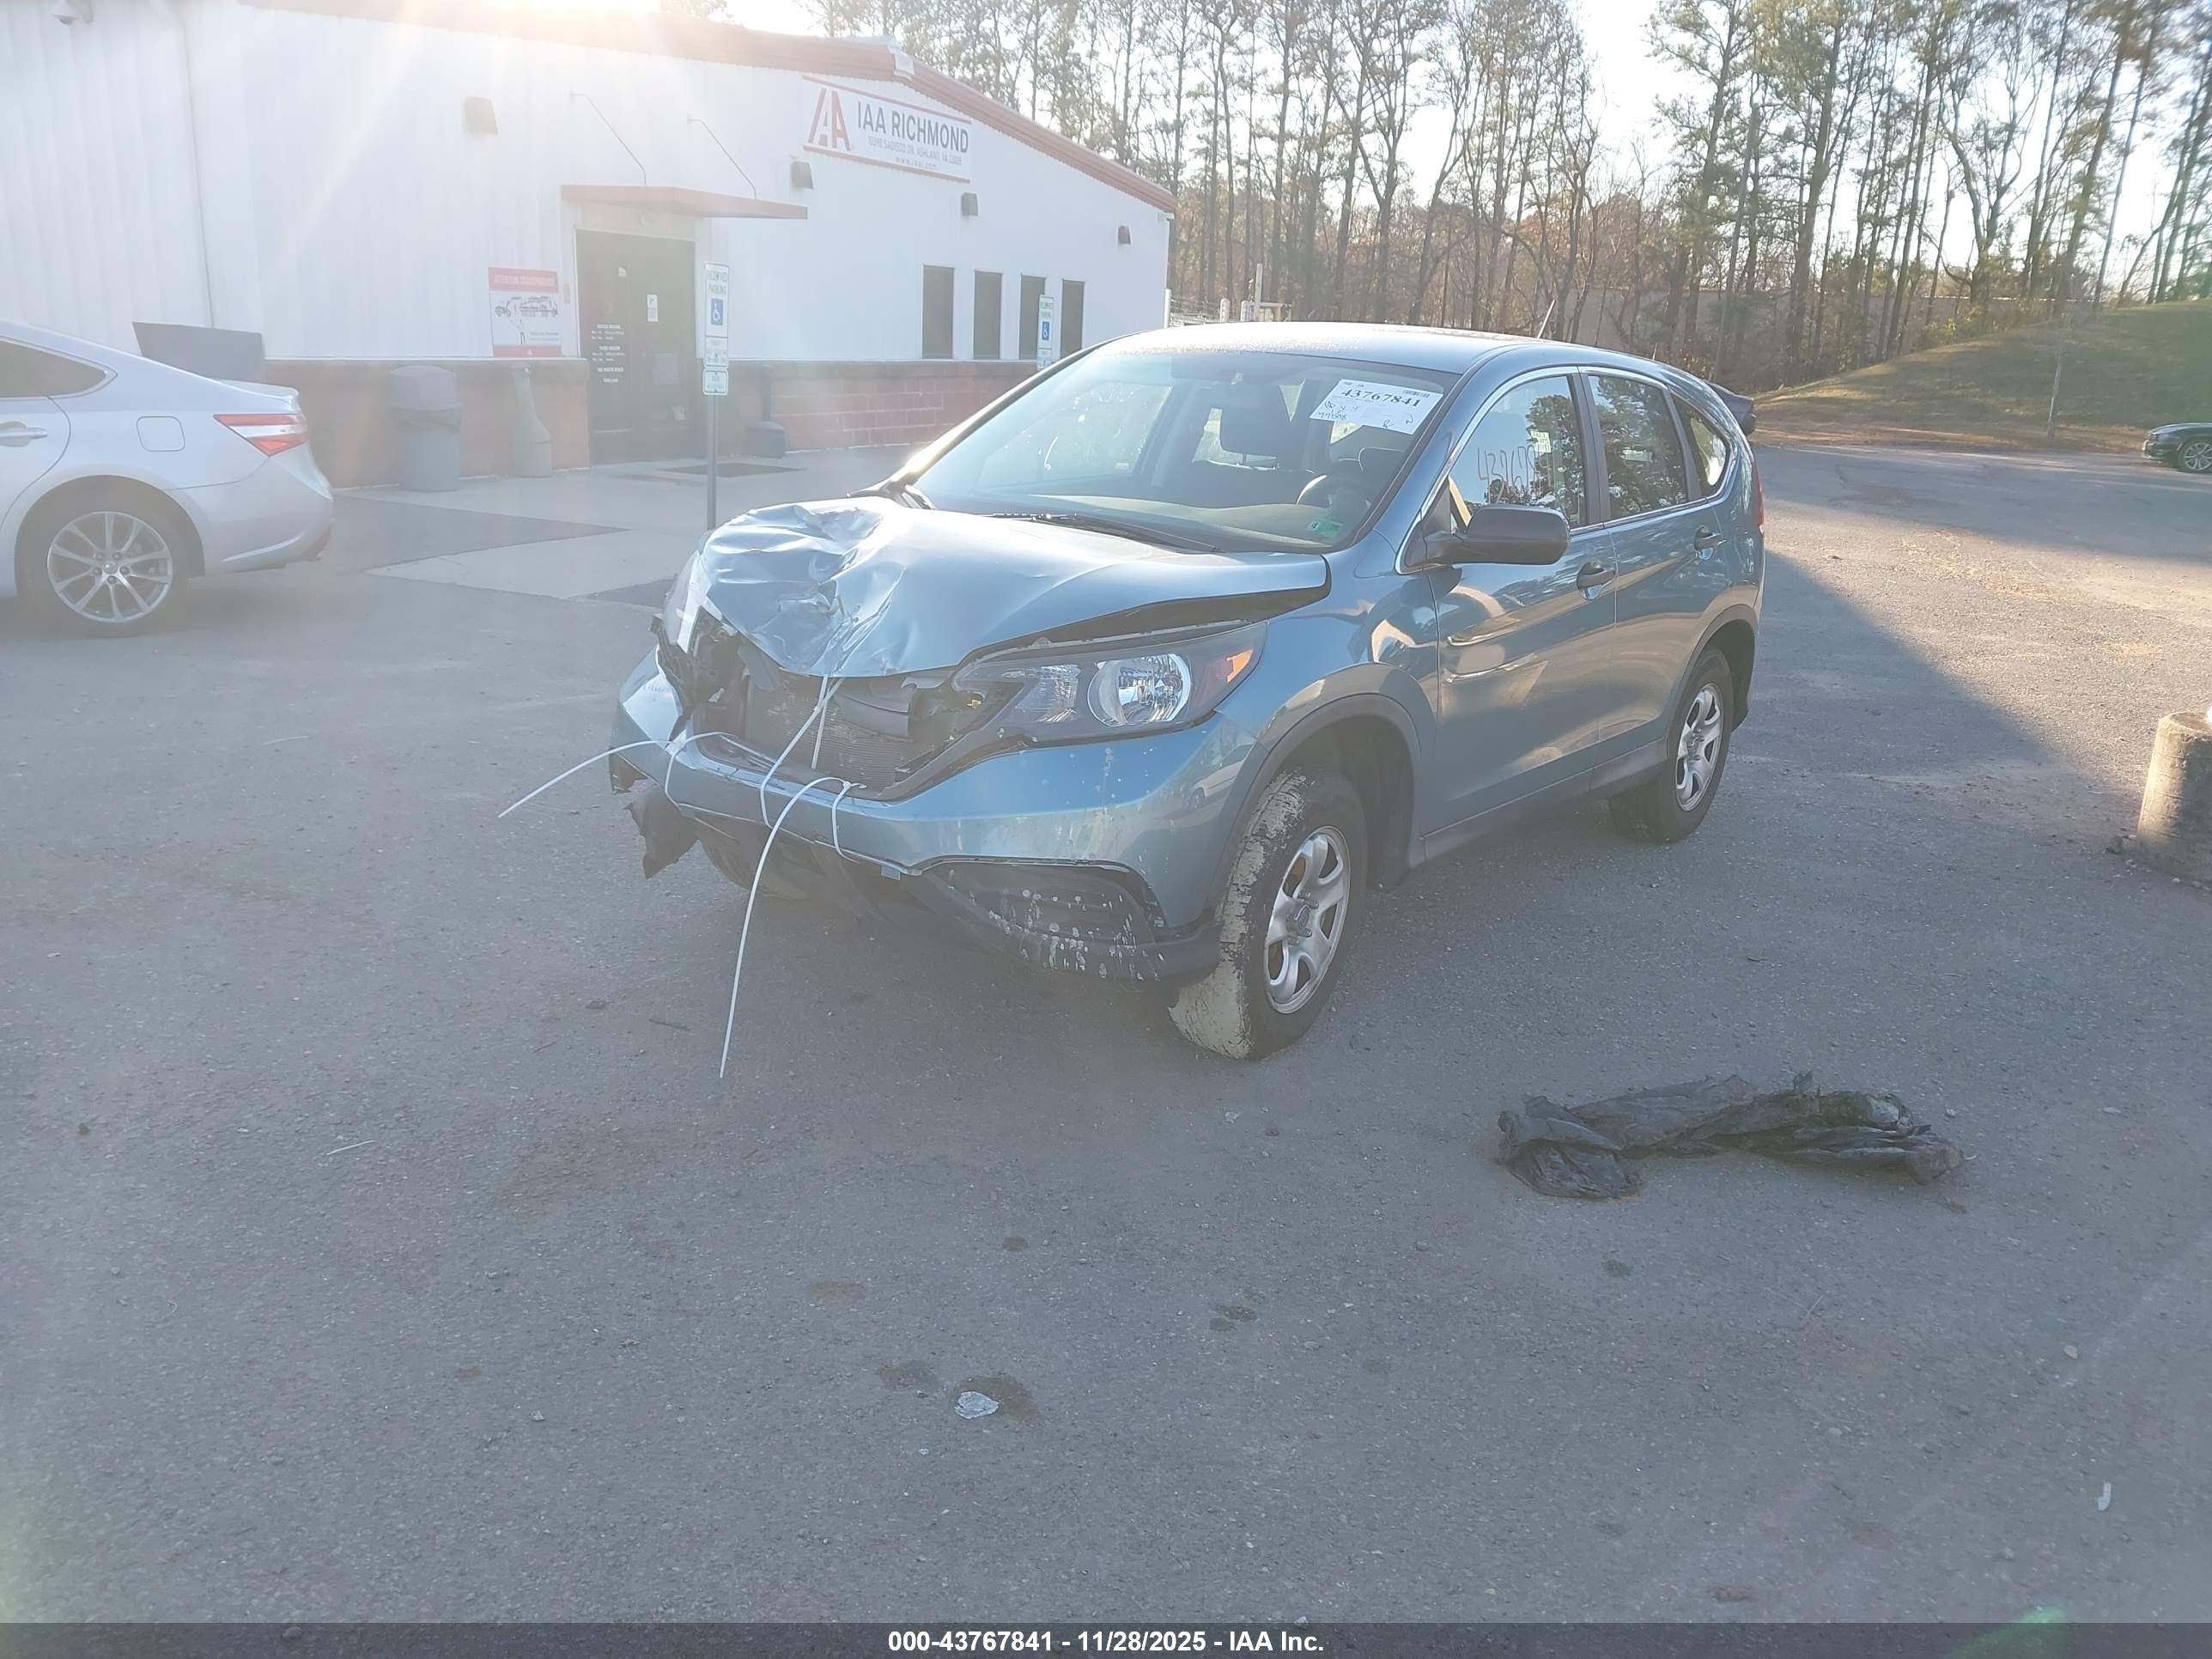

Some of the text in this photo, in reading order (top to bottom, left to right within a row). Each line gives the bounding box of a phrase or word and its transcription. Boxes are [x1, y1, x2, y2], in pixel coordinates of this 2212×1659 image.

[858, 100, 969, 153] IAA RICHMOND
[1341, 388, 1422, 407] 43767841
